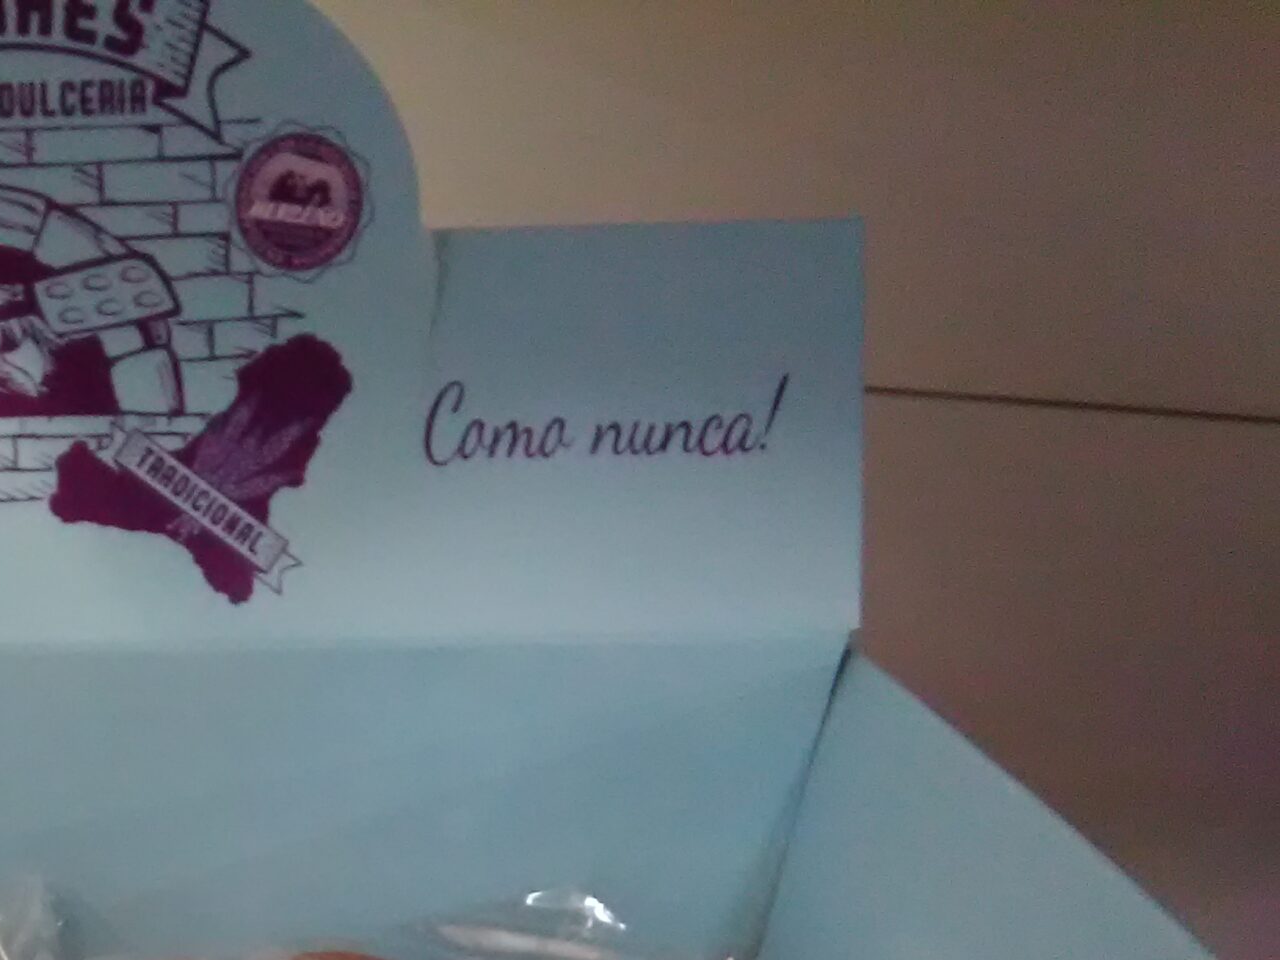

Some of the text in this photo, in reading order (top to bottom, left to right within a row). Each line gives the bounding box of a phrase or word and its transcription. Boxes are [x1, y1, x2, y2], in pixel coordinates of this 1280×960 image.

[421, 371, 791, 468] Como nunca!
[135, 445, 266, 556] TRADICIONAL
